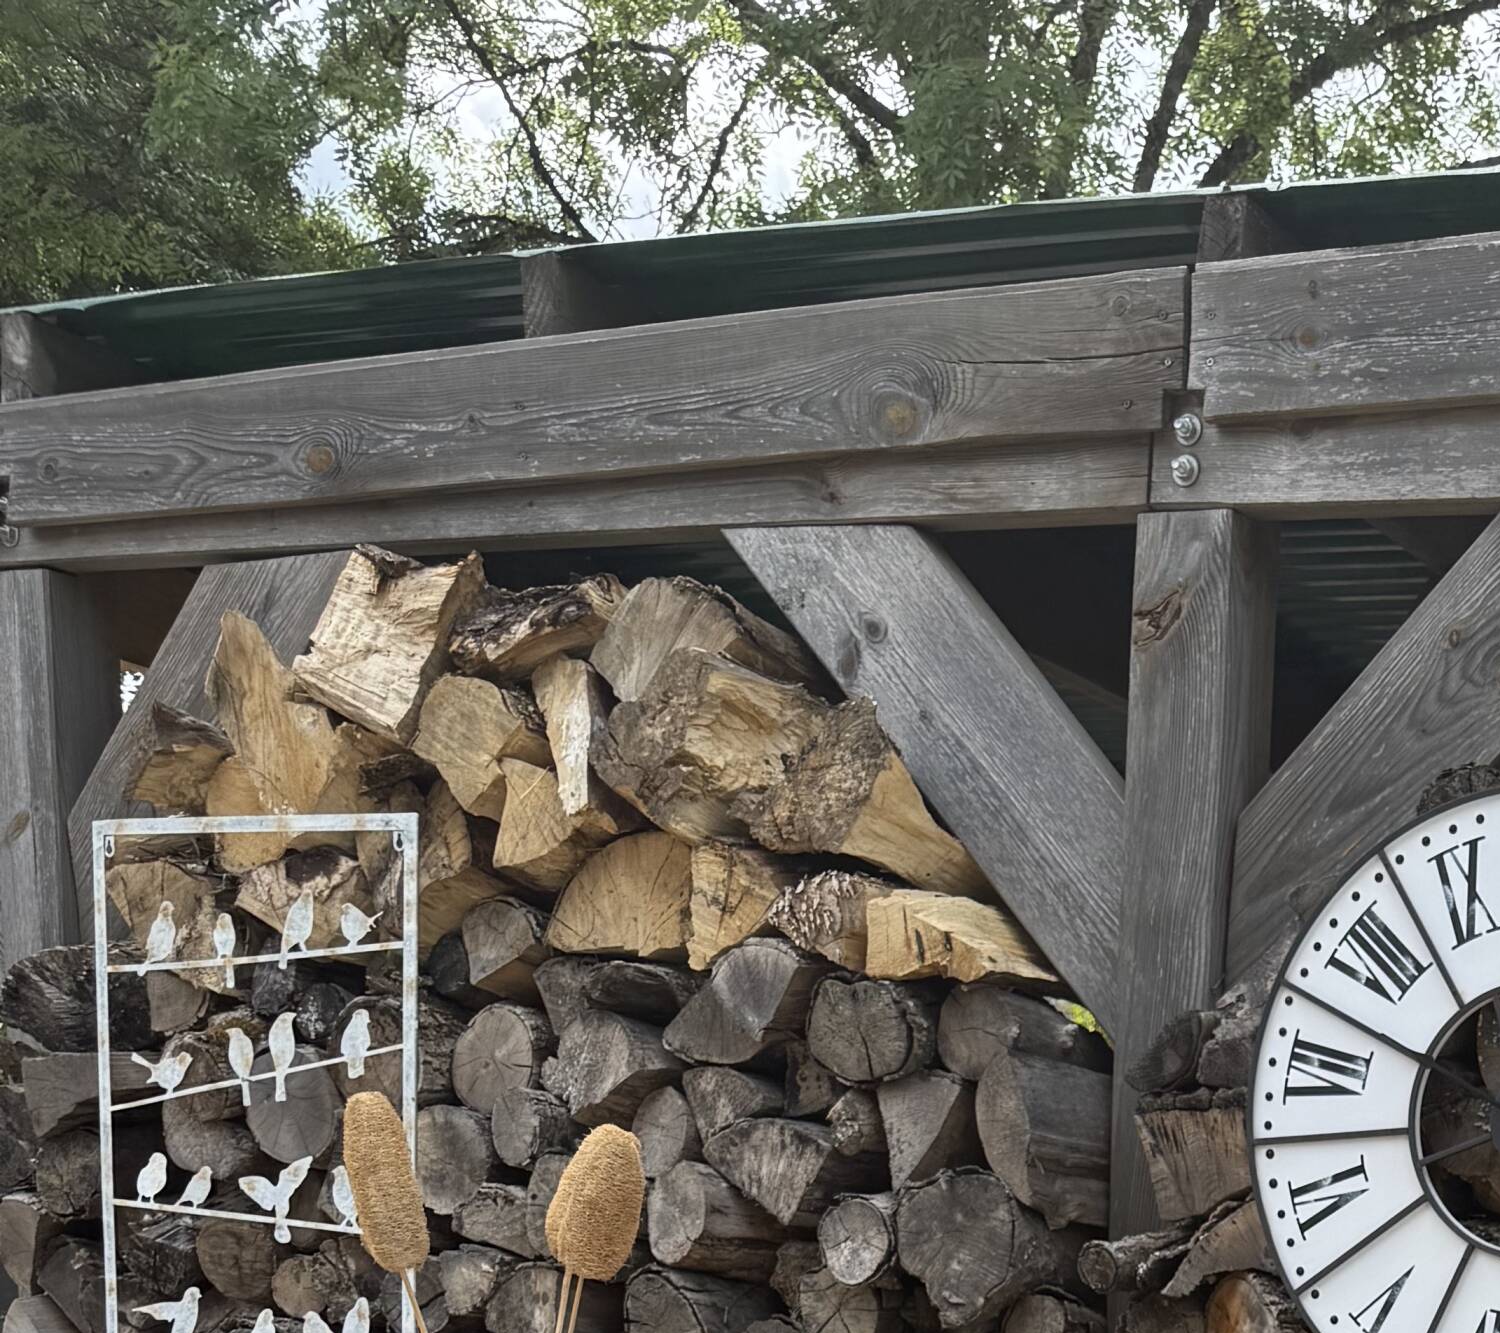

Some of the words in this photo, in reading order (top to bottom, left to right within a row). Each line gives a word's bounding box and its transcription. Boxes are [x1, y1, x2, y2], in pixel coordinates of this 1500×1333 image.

[1325, 900, 1433, 1004] VIII
[1283, 1029, 1374, 1105] VII
[1288, 1154, 1369, 1240] VI
